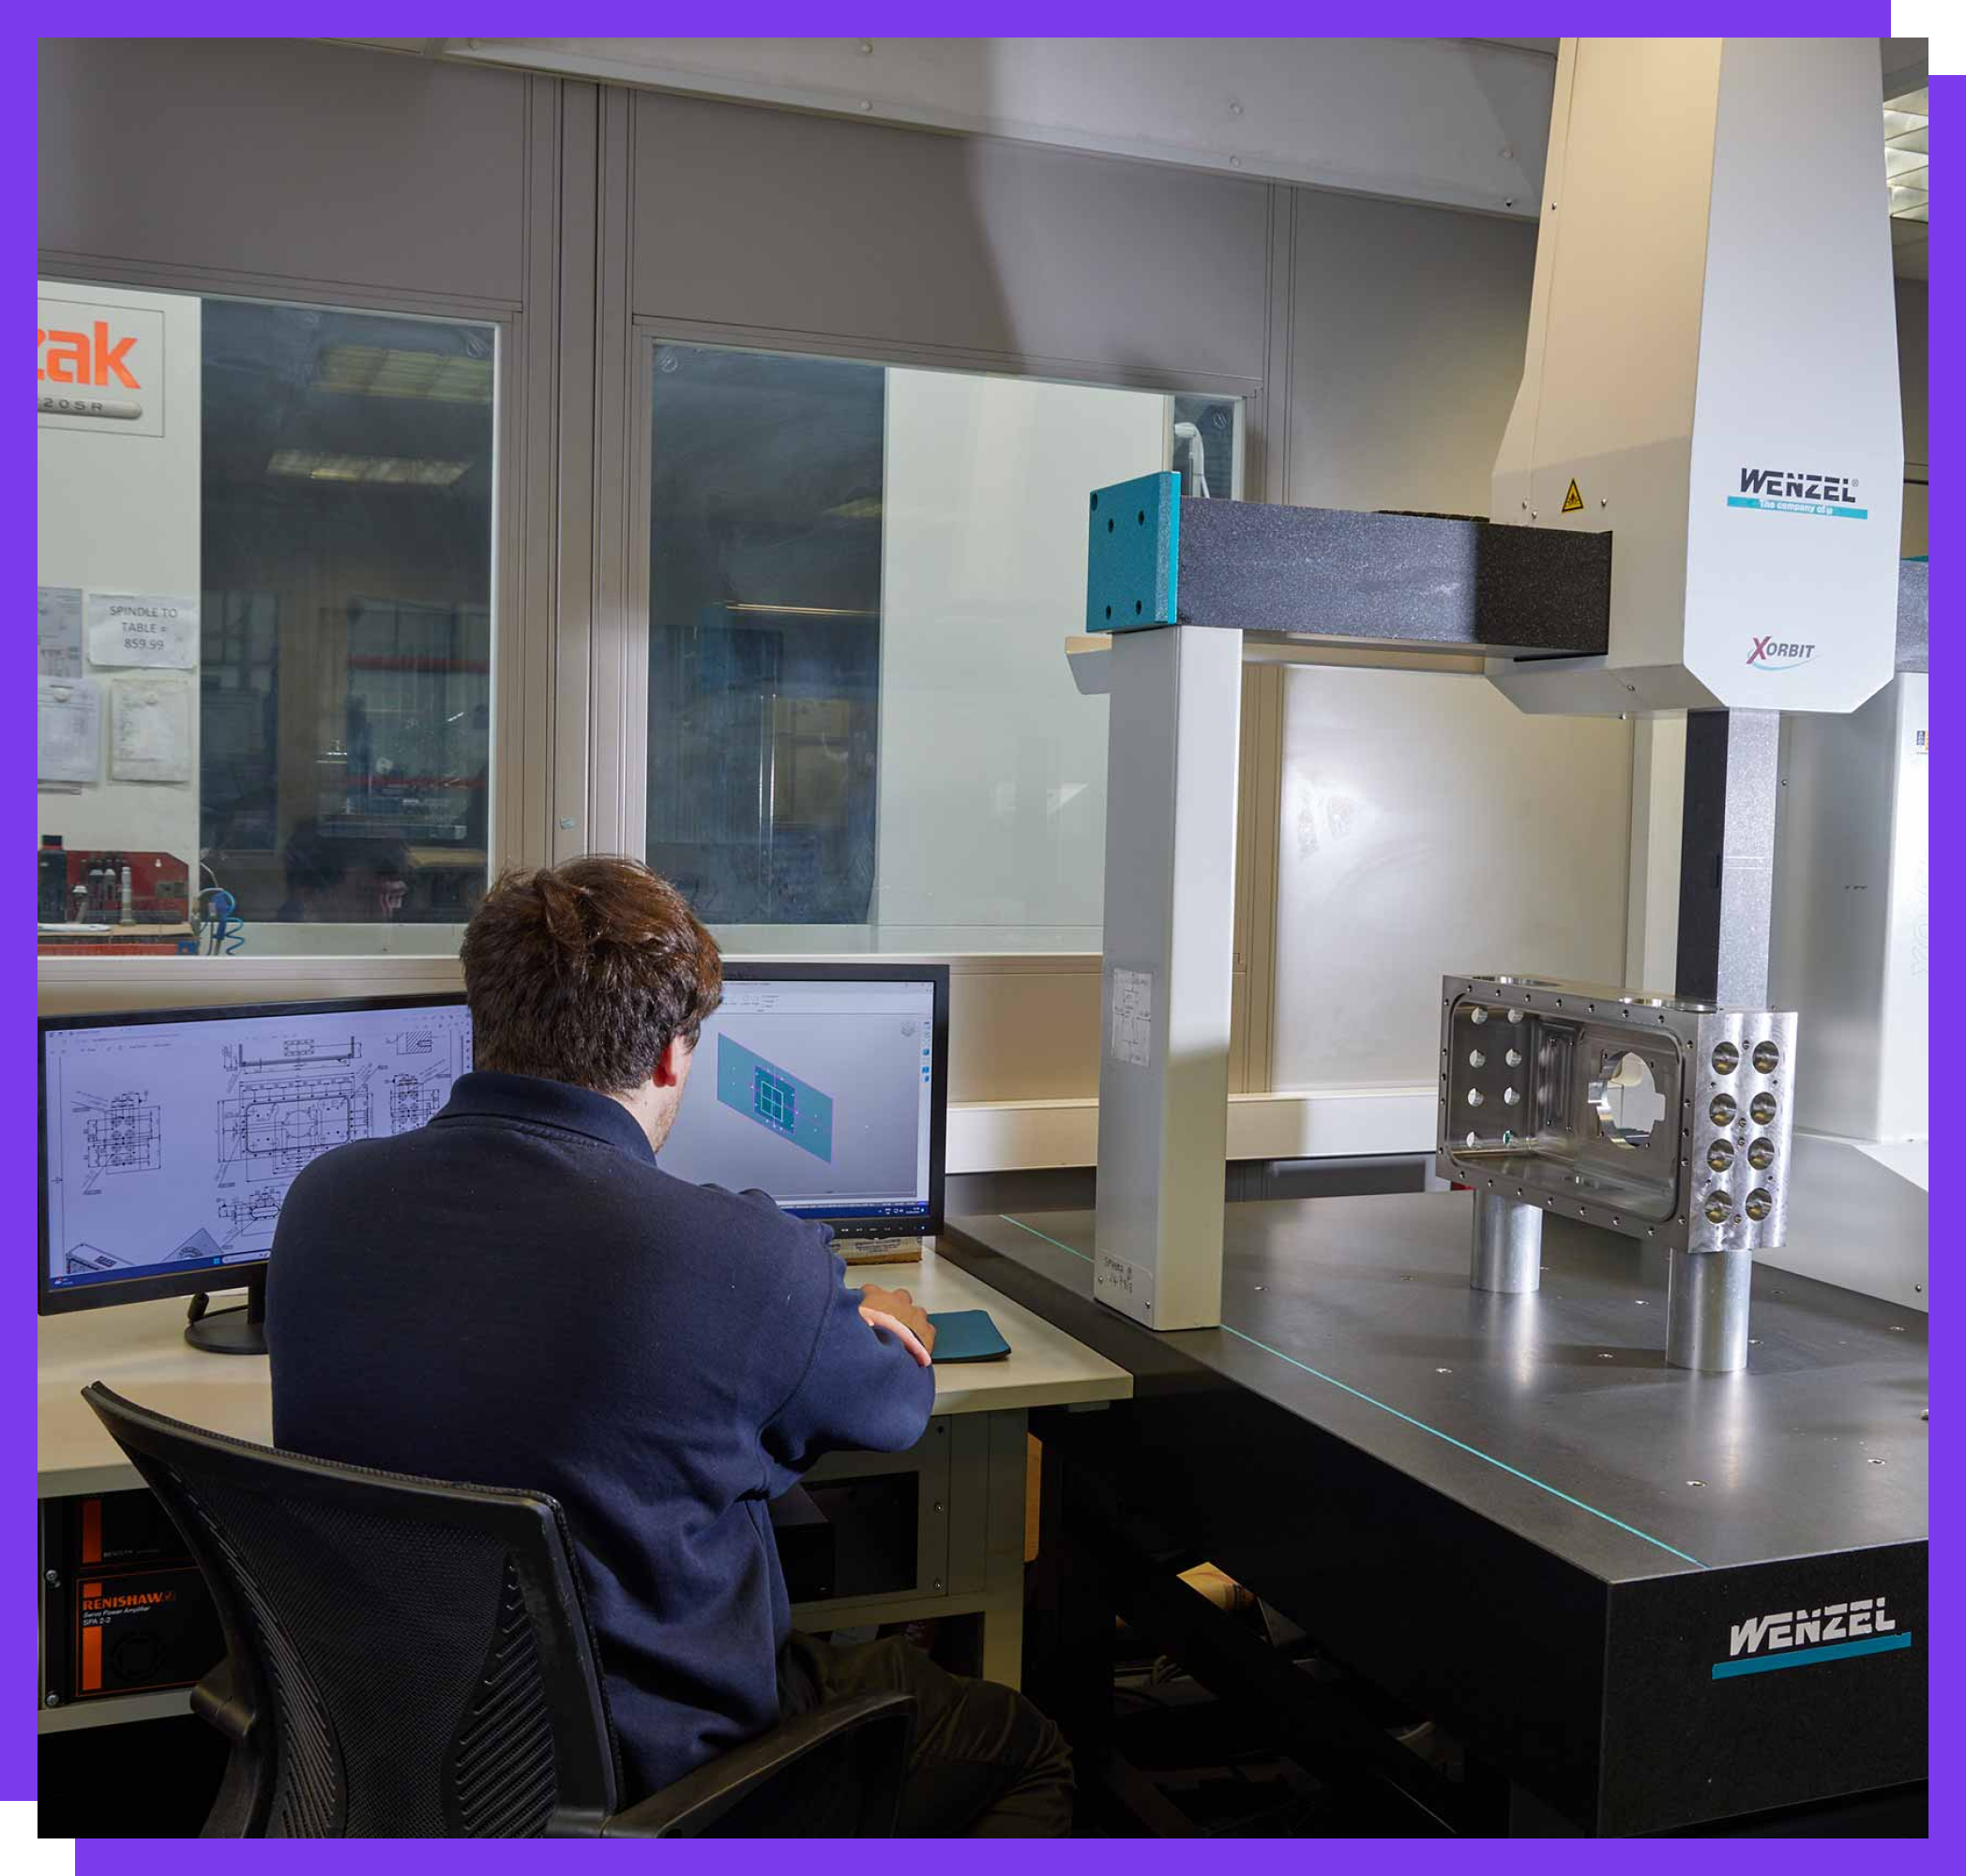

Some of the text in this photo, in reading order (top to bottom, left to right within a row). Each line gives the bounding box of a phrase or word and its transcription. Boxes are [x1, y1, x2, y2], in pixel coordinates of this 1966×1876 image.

[38, 321, 141, 389] ak
[1740, 467, 1856, 503] WENZEL
[1760, 499, 1776, 508] The
[1777, 501, 1816, 513] company
[110, 605, 178, 618] SPINDLE TO
[122, 622, 158, 633] TABLE
[124, 638, 164, 650] 859.99
[1747, 636, 1815, 664] XORBIT
[83, 1592, 162, 1611] RENISHAW
[83, 1605, 151, 1619] Servo Power Amplifier
[1730, 1596, 1896, 1657] WENZEL
